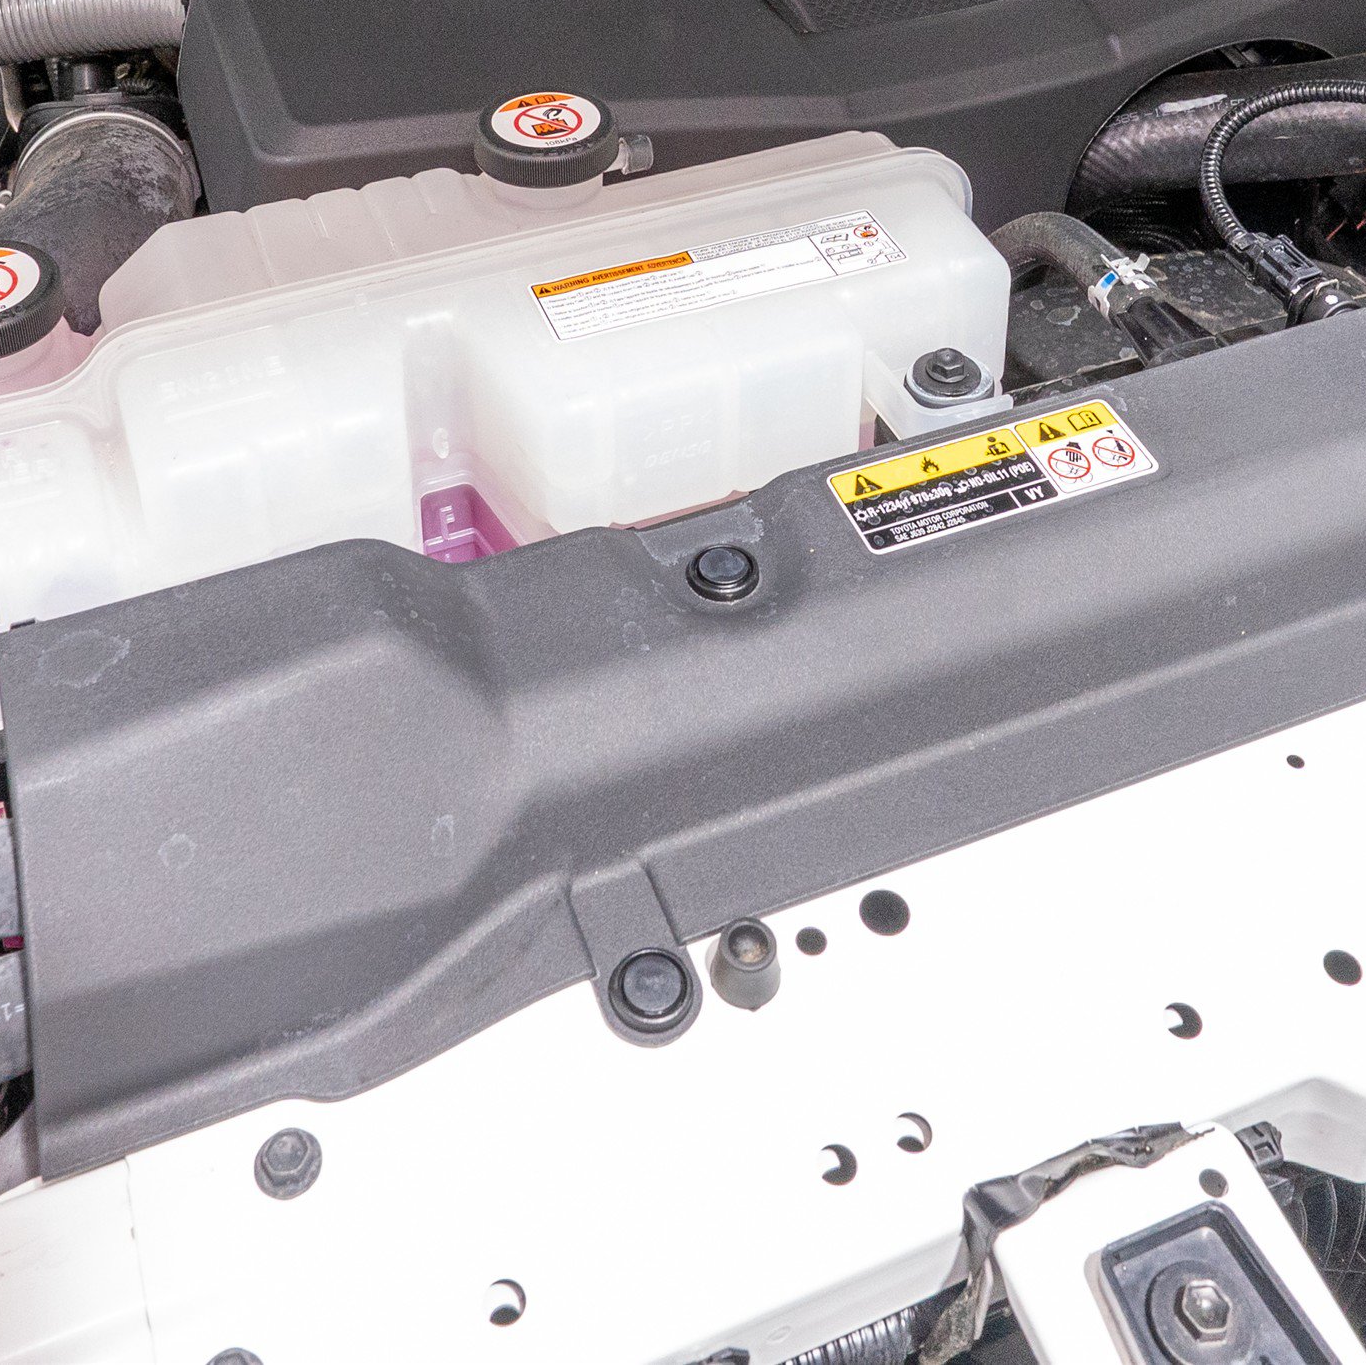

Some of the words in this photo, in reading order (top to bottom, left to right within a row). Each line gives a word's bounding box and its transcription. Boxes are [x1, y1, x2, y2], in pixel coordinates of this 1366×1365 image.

[551, 278, 590, 292] WARNING
[592, 265, 645, 282] AVERTISSEMENT
[968, 469, 1009, 488] ND-OIL11
[1010, 461, 1036, 478] (POE)
[1024, 486, 1046, 501] VY
[889, 521, 917, 535] TOYOTA
[917, 513, 943, 528] MOTOR
[942, 500, 989, 520] CORPORATION
[894, 533, 910, 543] SAE
